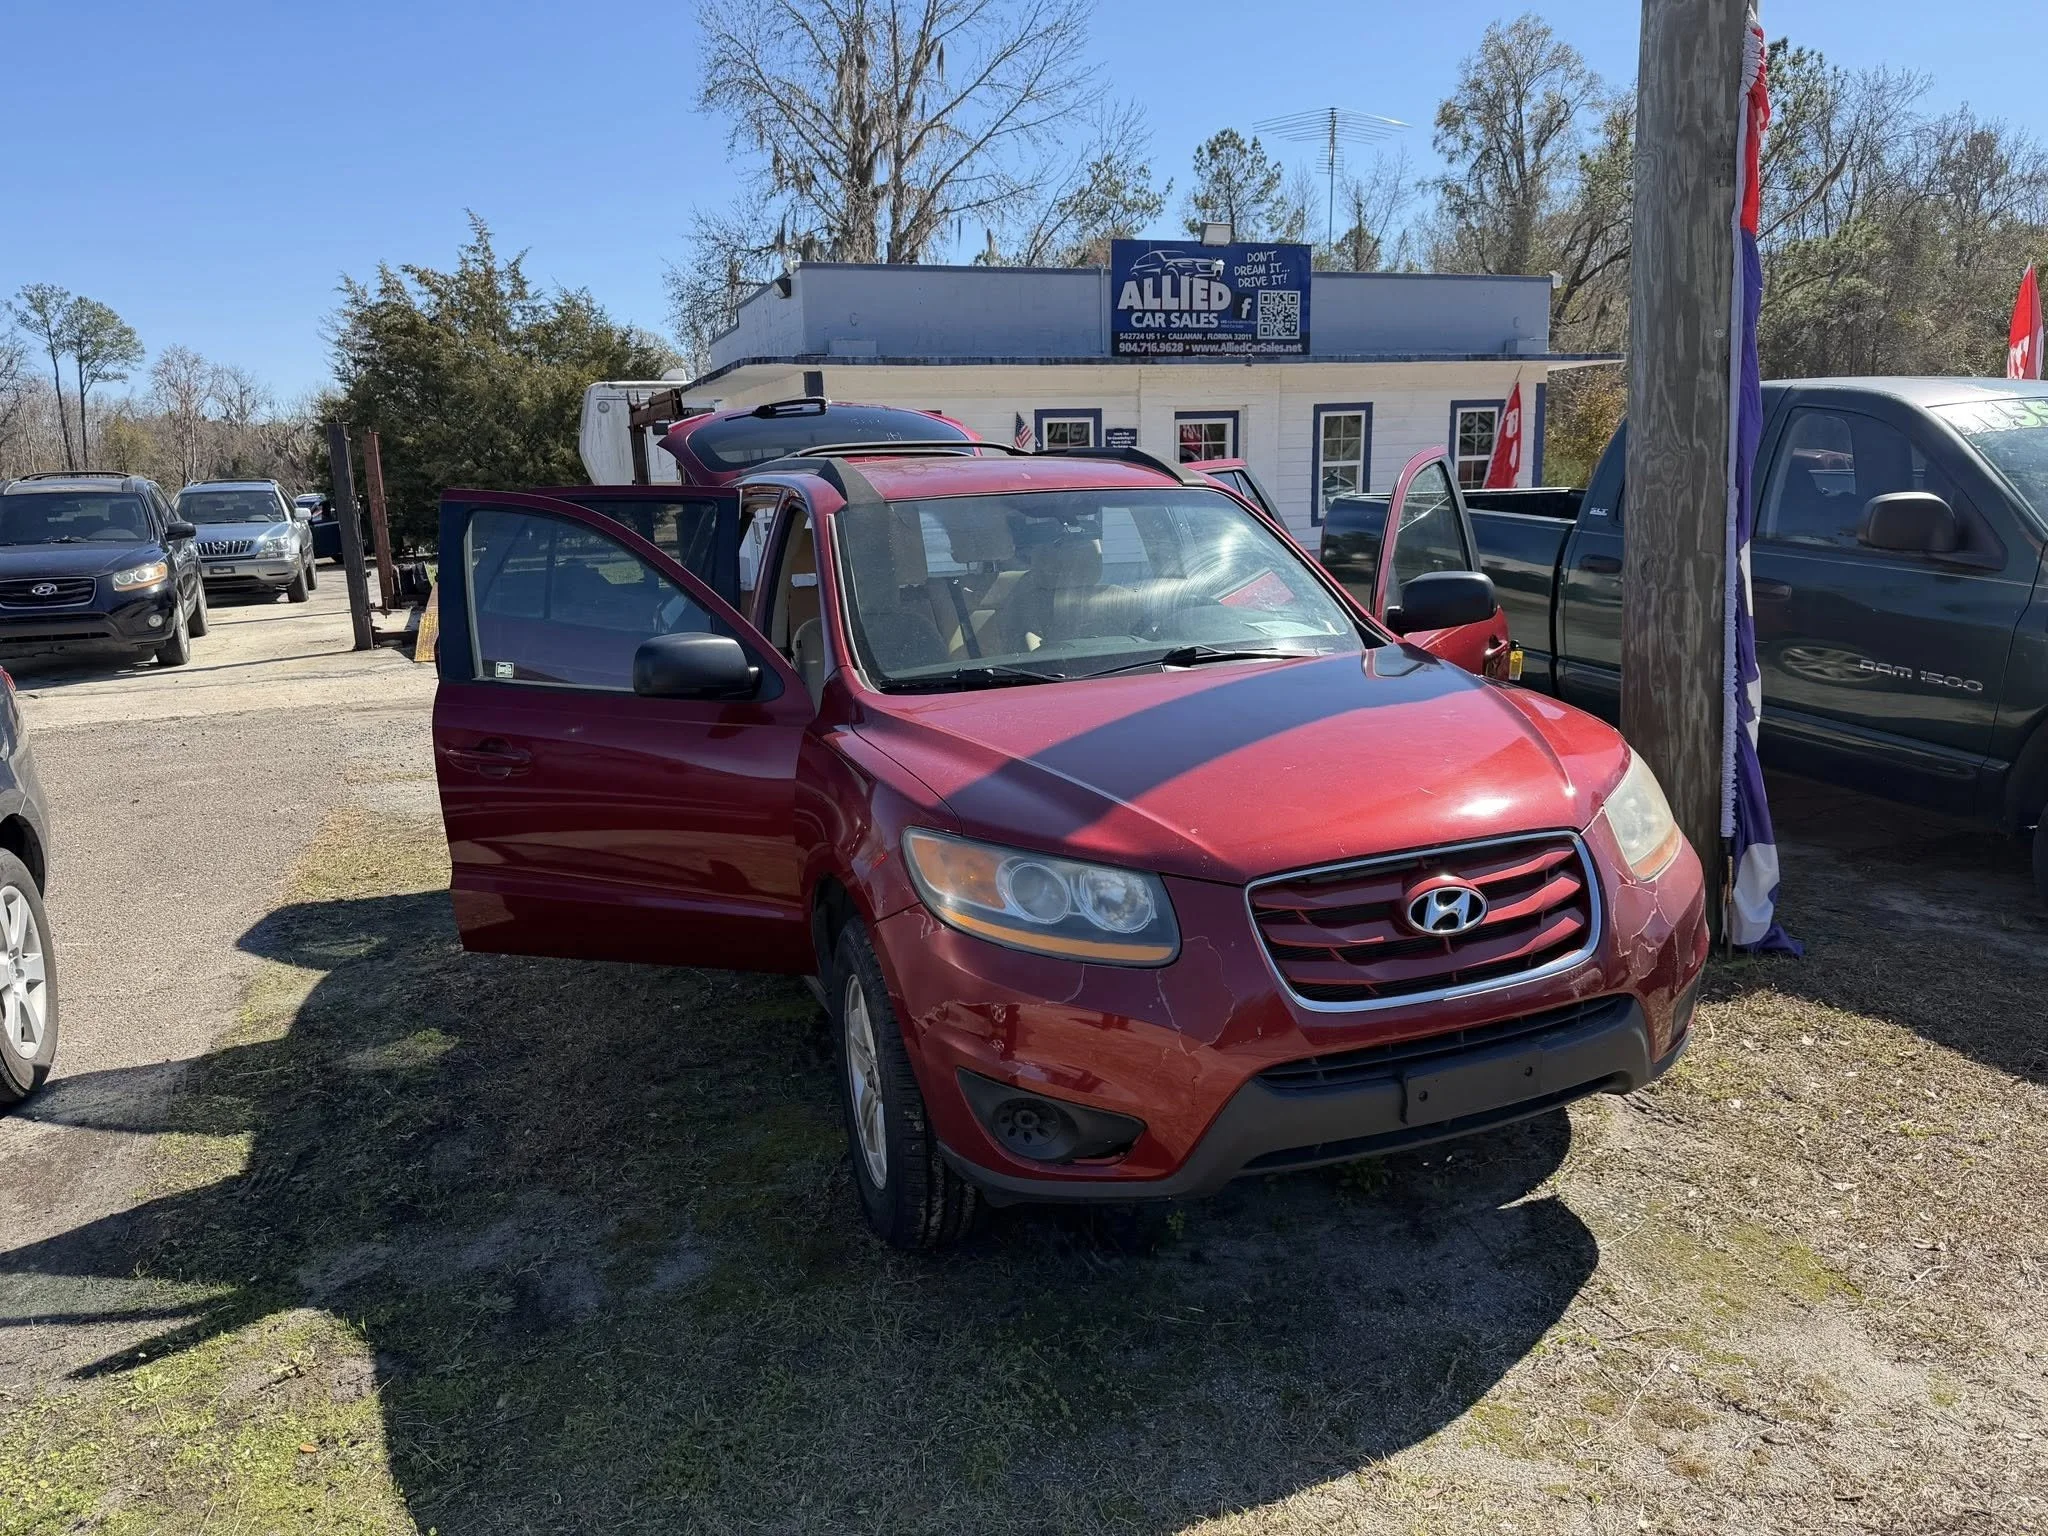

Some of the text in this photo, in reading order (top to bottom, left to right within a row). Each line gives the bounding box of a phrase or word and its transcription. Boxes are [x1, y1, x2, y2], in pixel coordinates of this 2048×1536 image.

[1247, 250, 1277, 263] DON'T
[1234, 262, 1290, 276] DREAM IT...
[1238, 273, 1287, 288] DRIVE IT!
[1117, 275, 1232, 311] ALLIED
[1130, 312, 1219, 328] CAR SALES
[1119, 332, 1145, 340] 542724
[1145, 332, 1155, 340] US
[1118, 342, 1303, 354] 904.716.9628 www.AlliedCarSales.net
[1859, 659, 1984, 692] RAM 1500
